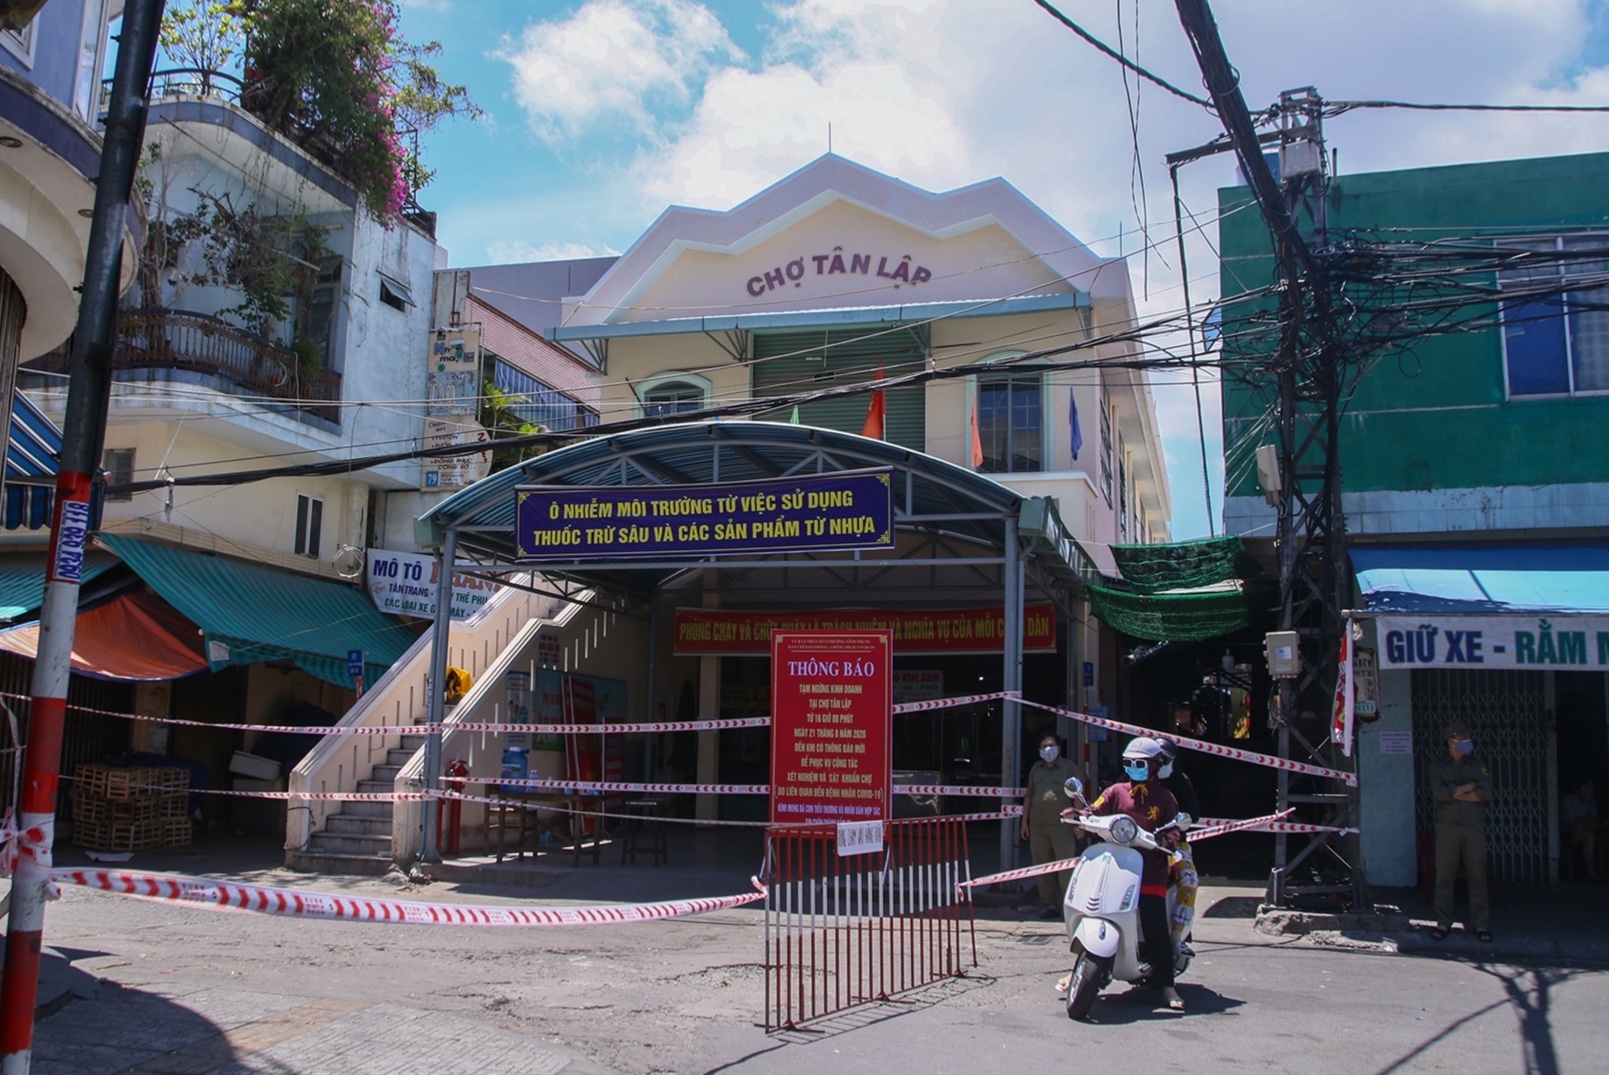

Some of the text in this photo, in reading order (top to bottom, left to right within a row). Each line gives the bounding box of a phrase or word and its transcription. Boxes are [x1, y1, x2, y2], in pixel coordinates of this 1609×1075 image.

[747, 246, 932, 297] CHỢ TÂN LẬP
[428, 473, 438, 485] 79
[550, 488, 853, 520] Ô NHIỄM MÔI TRƯỜNG TỪ VIỆC SỬ DỤNG
[65, 502, 89, 524] 118
[61, 526, 86, 549] 939
[534, 515, 875, 546] THUỐC TRỪ SÂU VÀ CÁC SẢN PHẨM TỪ NHỰA
[58, 550, 83, 579] 0934
[373, 558, 398, 578] MÔ
[404, 561, 422, 581] TÔ
[385, 597, 399, 608] CÁC
[419, 603, 429, 612] XE
[680, 618, 711, 640] PHÒNG
[713, 618, 737, 640] CHÁY
[740, 619, 752, 640] VÀ
[905, 617, 934, 639] NGHĨA
[937, 619, 950, 643] VỤ
[952, 614, 972, 639] CỦA
[1028, 613, 1049, 636] DÂN
[1386, 624, 1438, 664] GIỮ
[1444, 631, 1484, 663] XE
[1515, 618, 1588, 665] RẰM
[788, 657, 875, 677] THÔNG BÁO
[800, 684, 810, 695] TẠM
[831, 685, 843, 693] KINH
[845, 685, 862, 694] DOANH
[809, 698, 852, 710] TẠI CHỢ TÂN LẬP
[807, 713, 814, 722] TỪ
[823, 712, 831, 723] GIỜ
[840, 713, 853, 723] PHÚT
[794, 727, 808, 737] NGÀY
[817, 727, 834, 738] THÁNG
[840, 728, 852, 738] NĂM
[853, 730, 866, 738] 2020
[795, 741, 865, 753] ĐẾN KHI CÓ THÔNG BÁO MỚI
[801, 754, 858, 769] ĐỂ PHỤC VỤ CÔNG TÁC
[787, 770, 796, 781] XÉT
[798, 771, 818, 783] NGHIỆM
[820, 771, 826, 782] VÀ
[842, 771, 860, 783] KHUẨN
[861, 774, 872, 785] CHỢ
[786, 785, 798, 796] LIÊN
[800, 787, 813, 797] QUAN
[814, 786, 824, 797] ĐẾN
[826, 787, 840, 799] BỆNH
[841, 787, 856, 798] NHÂN
